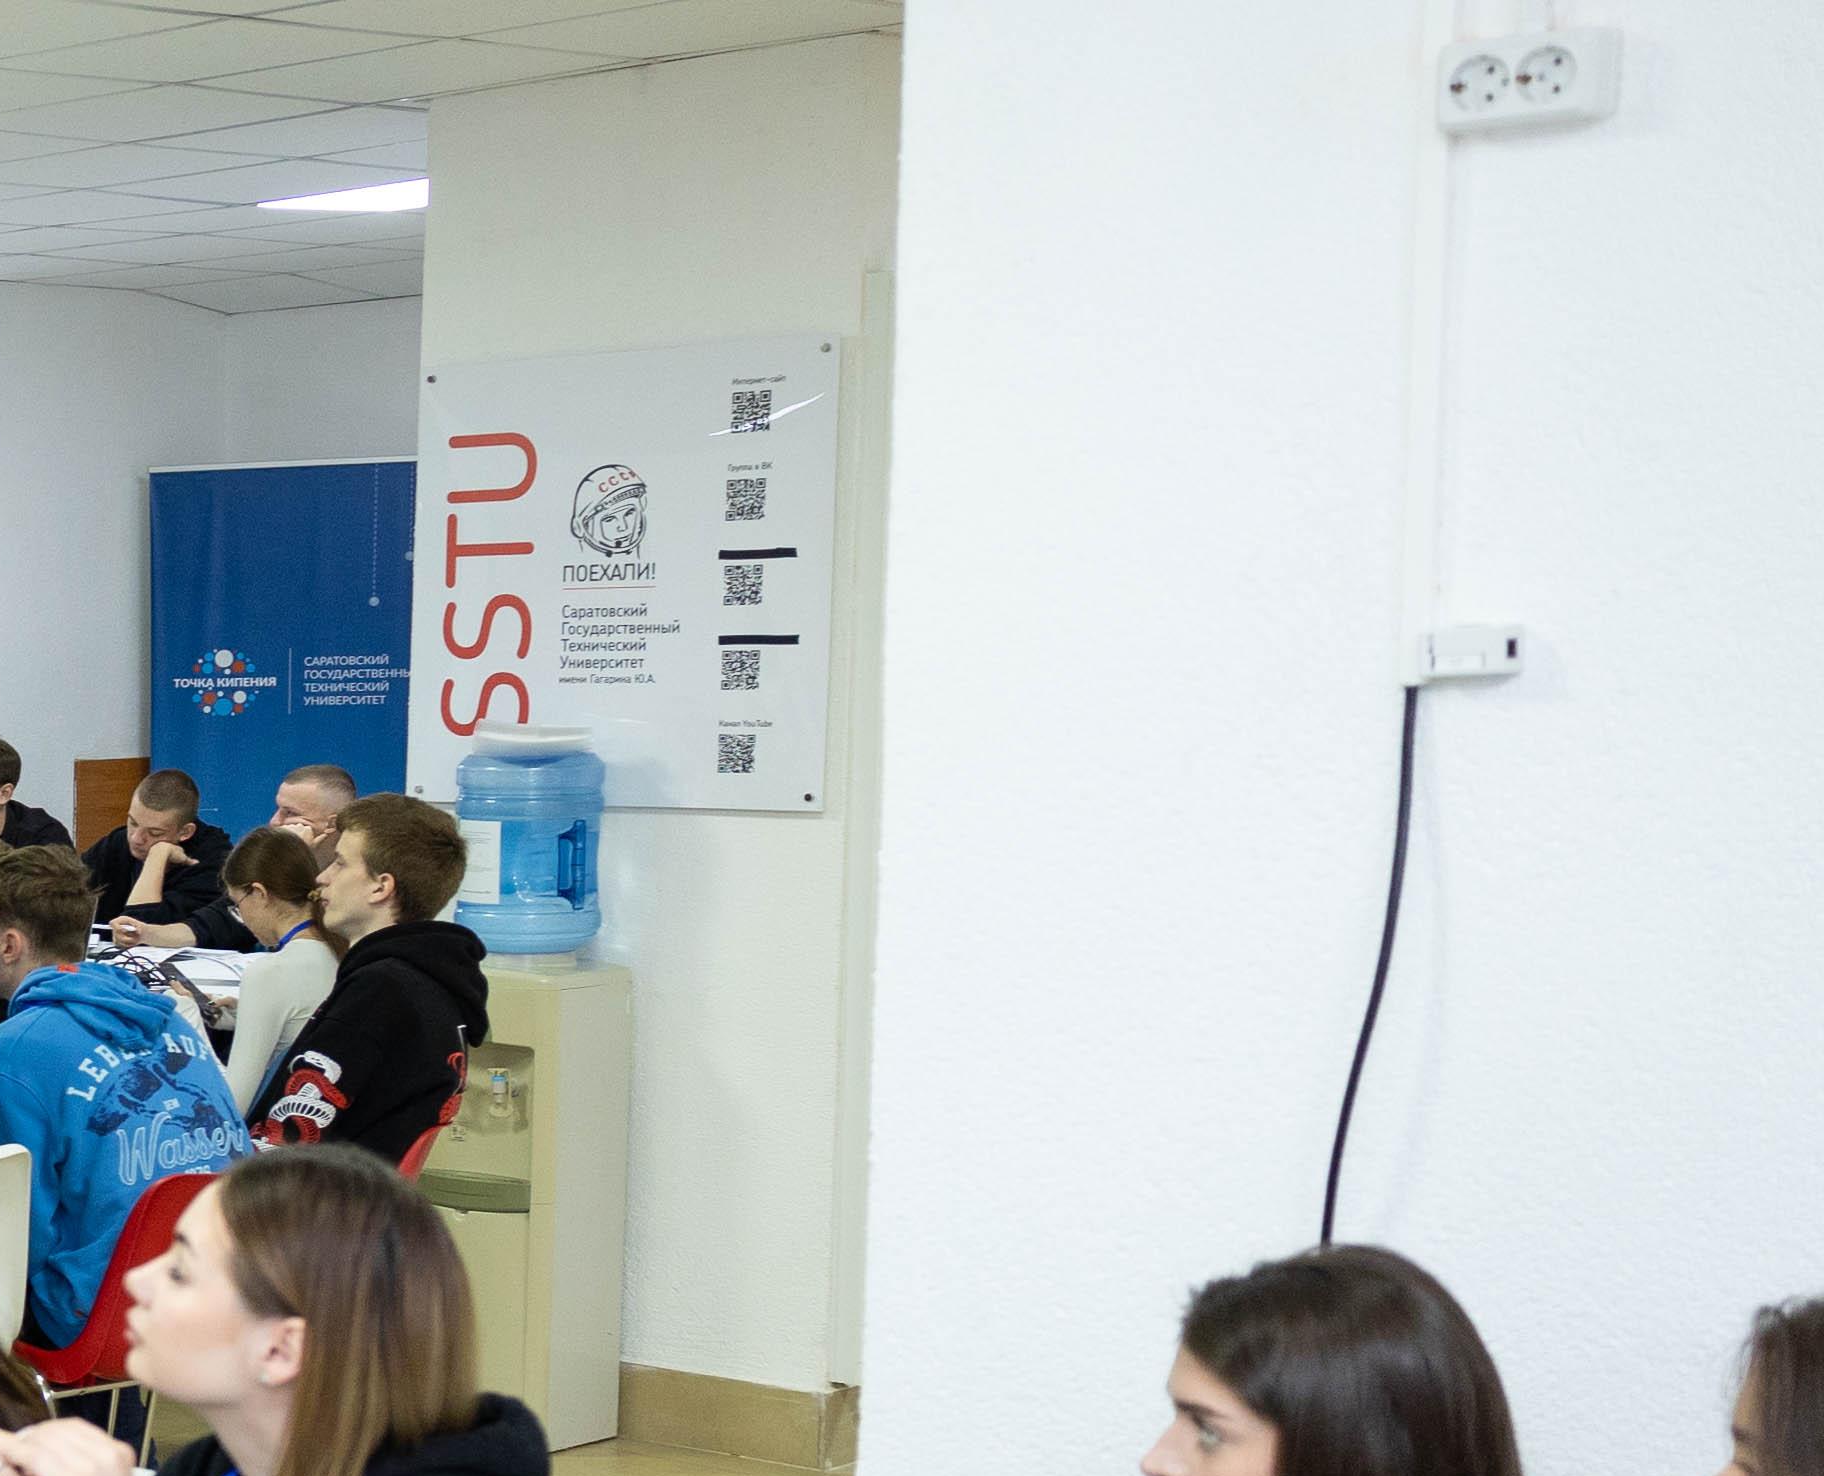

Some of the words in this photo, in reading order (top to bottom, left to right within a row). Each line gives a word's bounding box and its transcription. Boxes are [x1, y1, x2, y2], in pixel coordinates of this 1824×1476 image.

[761, 462, 773, 470] ВК
[562, 562, 657, 582] ПОЕХАЛИ!
[440, 431, 538, 737] SSTU
[561, 603, 648, 620] Саратовский
[560, 620, 681, 638] Государственный
[560, 638, 647, 652] Технический
[304, 654, 390, 666] САРАТОВСКИЙ
[560, 656, 644, 671] Университет
[304, 668, 410, 680] ГОСУДАРСТВЕННЫ
[558, 676, 587, 684] имени
[590, 675, 631, 685] Гагарина
[173, 677, 215, 688] ТОЧКА
[217, 676, 277, 688] КИПЕНИЯ
[304, 681, 390, 692] ТЕХНИЧЕСКИЙ
[304, 695, 386, 706] УНИВЕРСИТЕТ
[116, 1111, 245, 1186] Wasser
